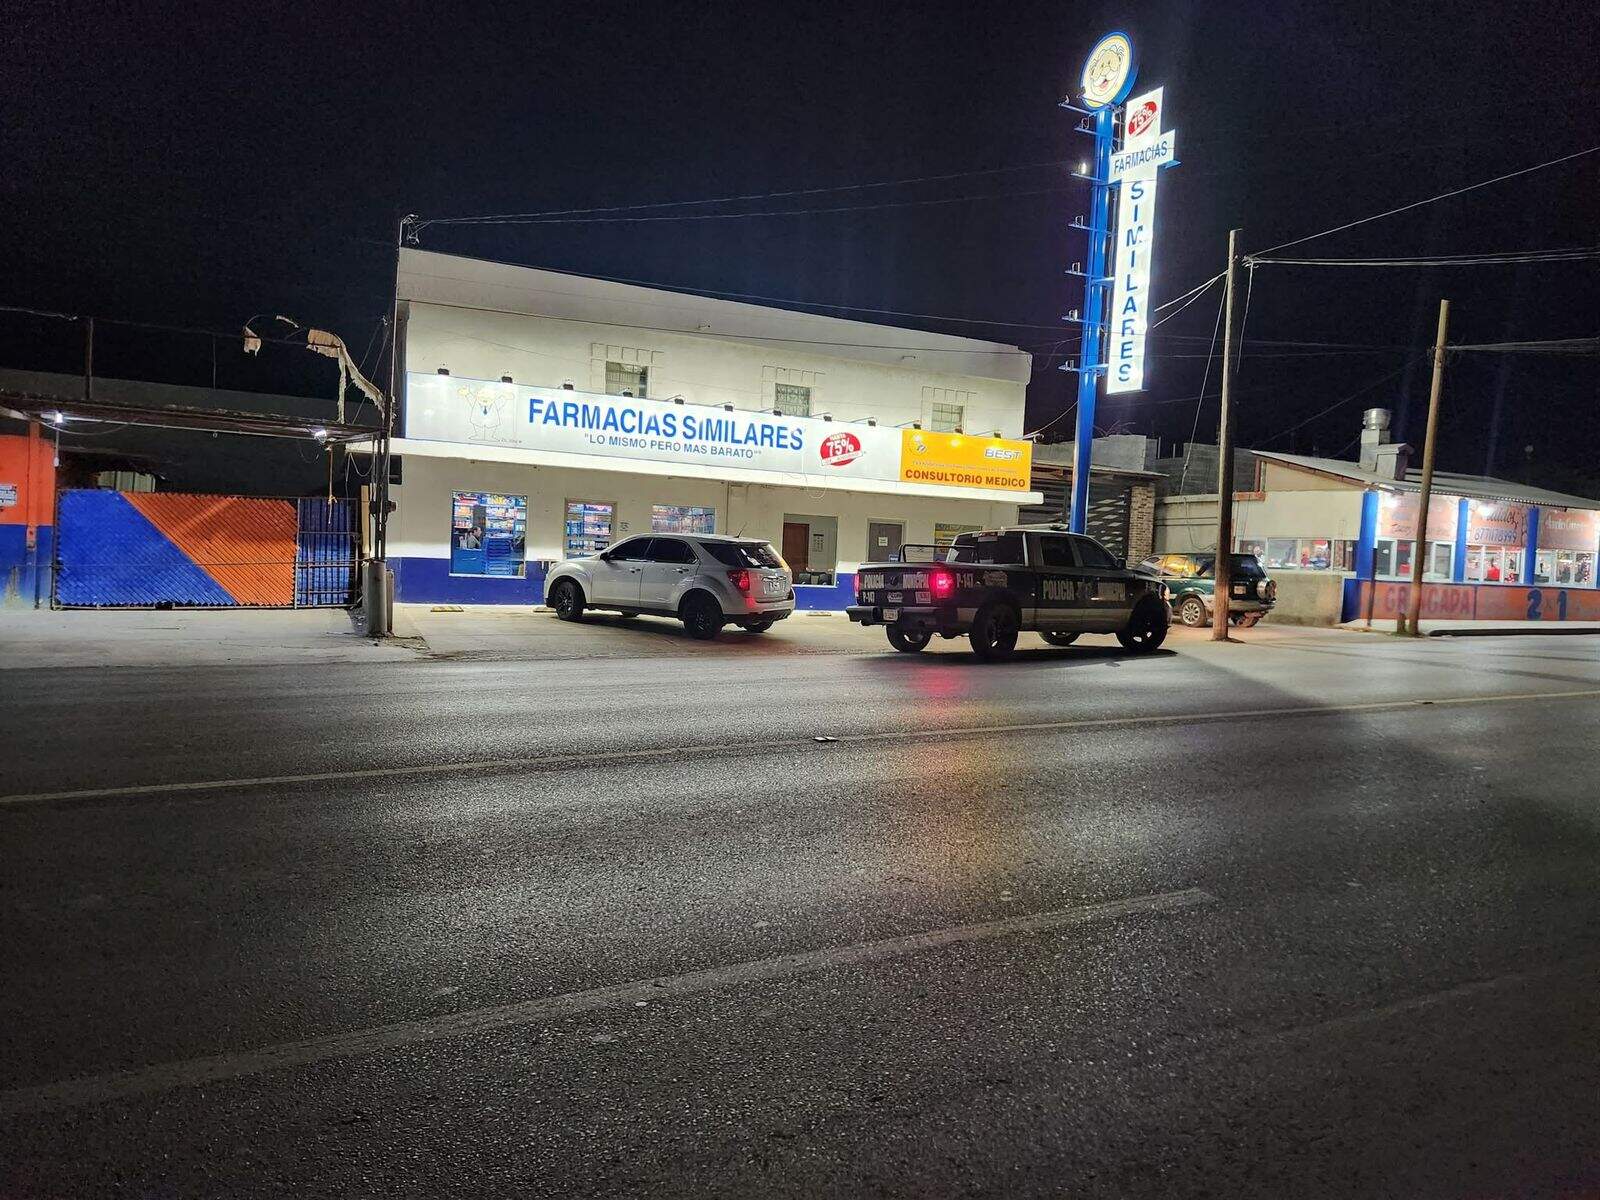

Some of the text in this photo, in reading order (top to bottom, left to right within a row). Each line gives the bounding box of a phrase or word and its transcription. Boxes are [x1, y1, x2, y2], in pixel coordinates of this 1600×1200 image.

[1114, 141, 1168, 175] FARMACIAS
[1118, 180, 1144, 382] SIMILARES
[529, 398, 803, 451] FARMACIAS SIMILARES
[609, 435, 647, 449] MISMO
[650, 440, 681, 452] PERO
[683, 443, 708, 455] MAS
[826, 437, 855, 457] 75%
[985, 447, 1022, 459] BEST
[905, 469, 1026, 488] CONSULTORIO MEDICO
